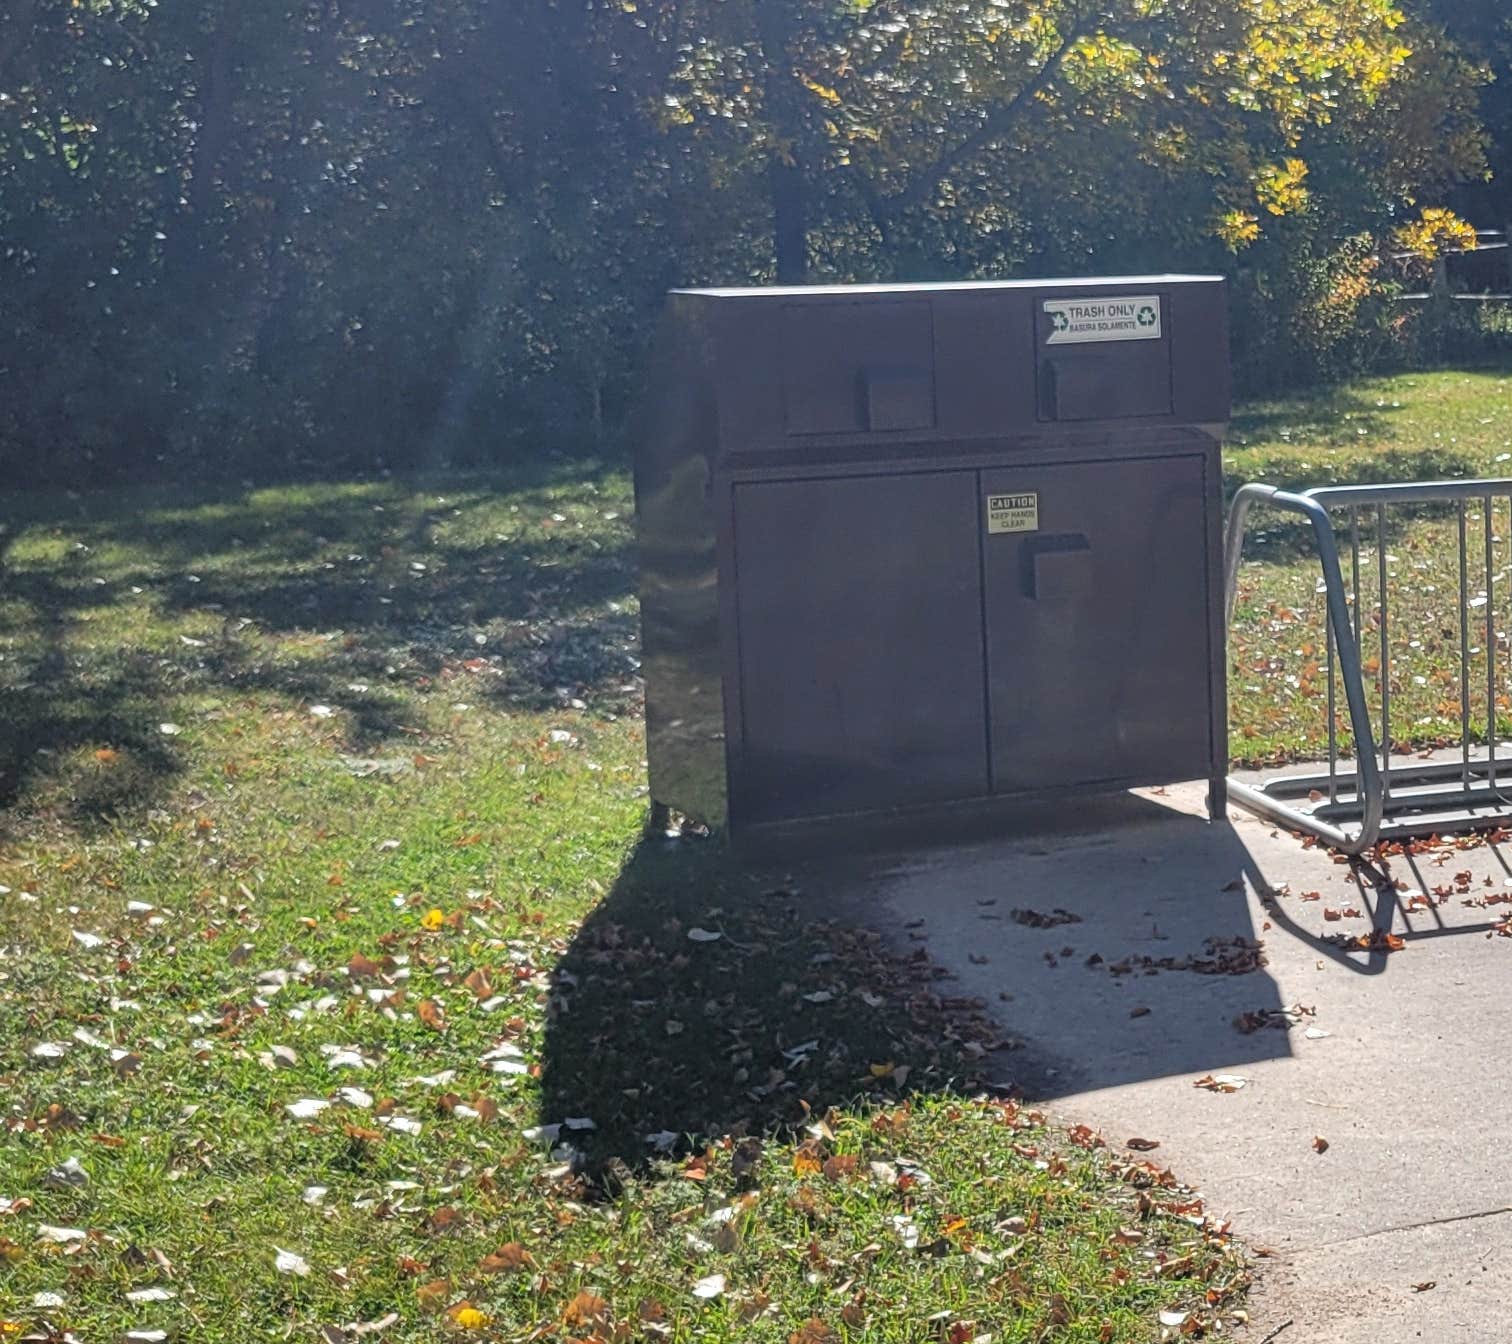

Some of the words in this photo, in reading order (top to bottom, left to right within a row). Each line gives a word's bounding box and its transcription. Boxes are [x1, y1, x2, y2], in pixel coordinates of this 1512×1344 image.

[1069, 305, 1105, 318] TRASH
[1108, 304, 1136, 317] ONLY
[1069, 322, 1096, 332] BASURA
[1098, 321, 1137, 331] SOLAMENTE
[991, 497, 1035, 508] CAUTION
[1011, 510, 1035, 518] HANDS
